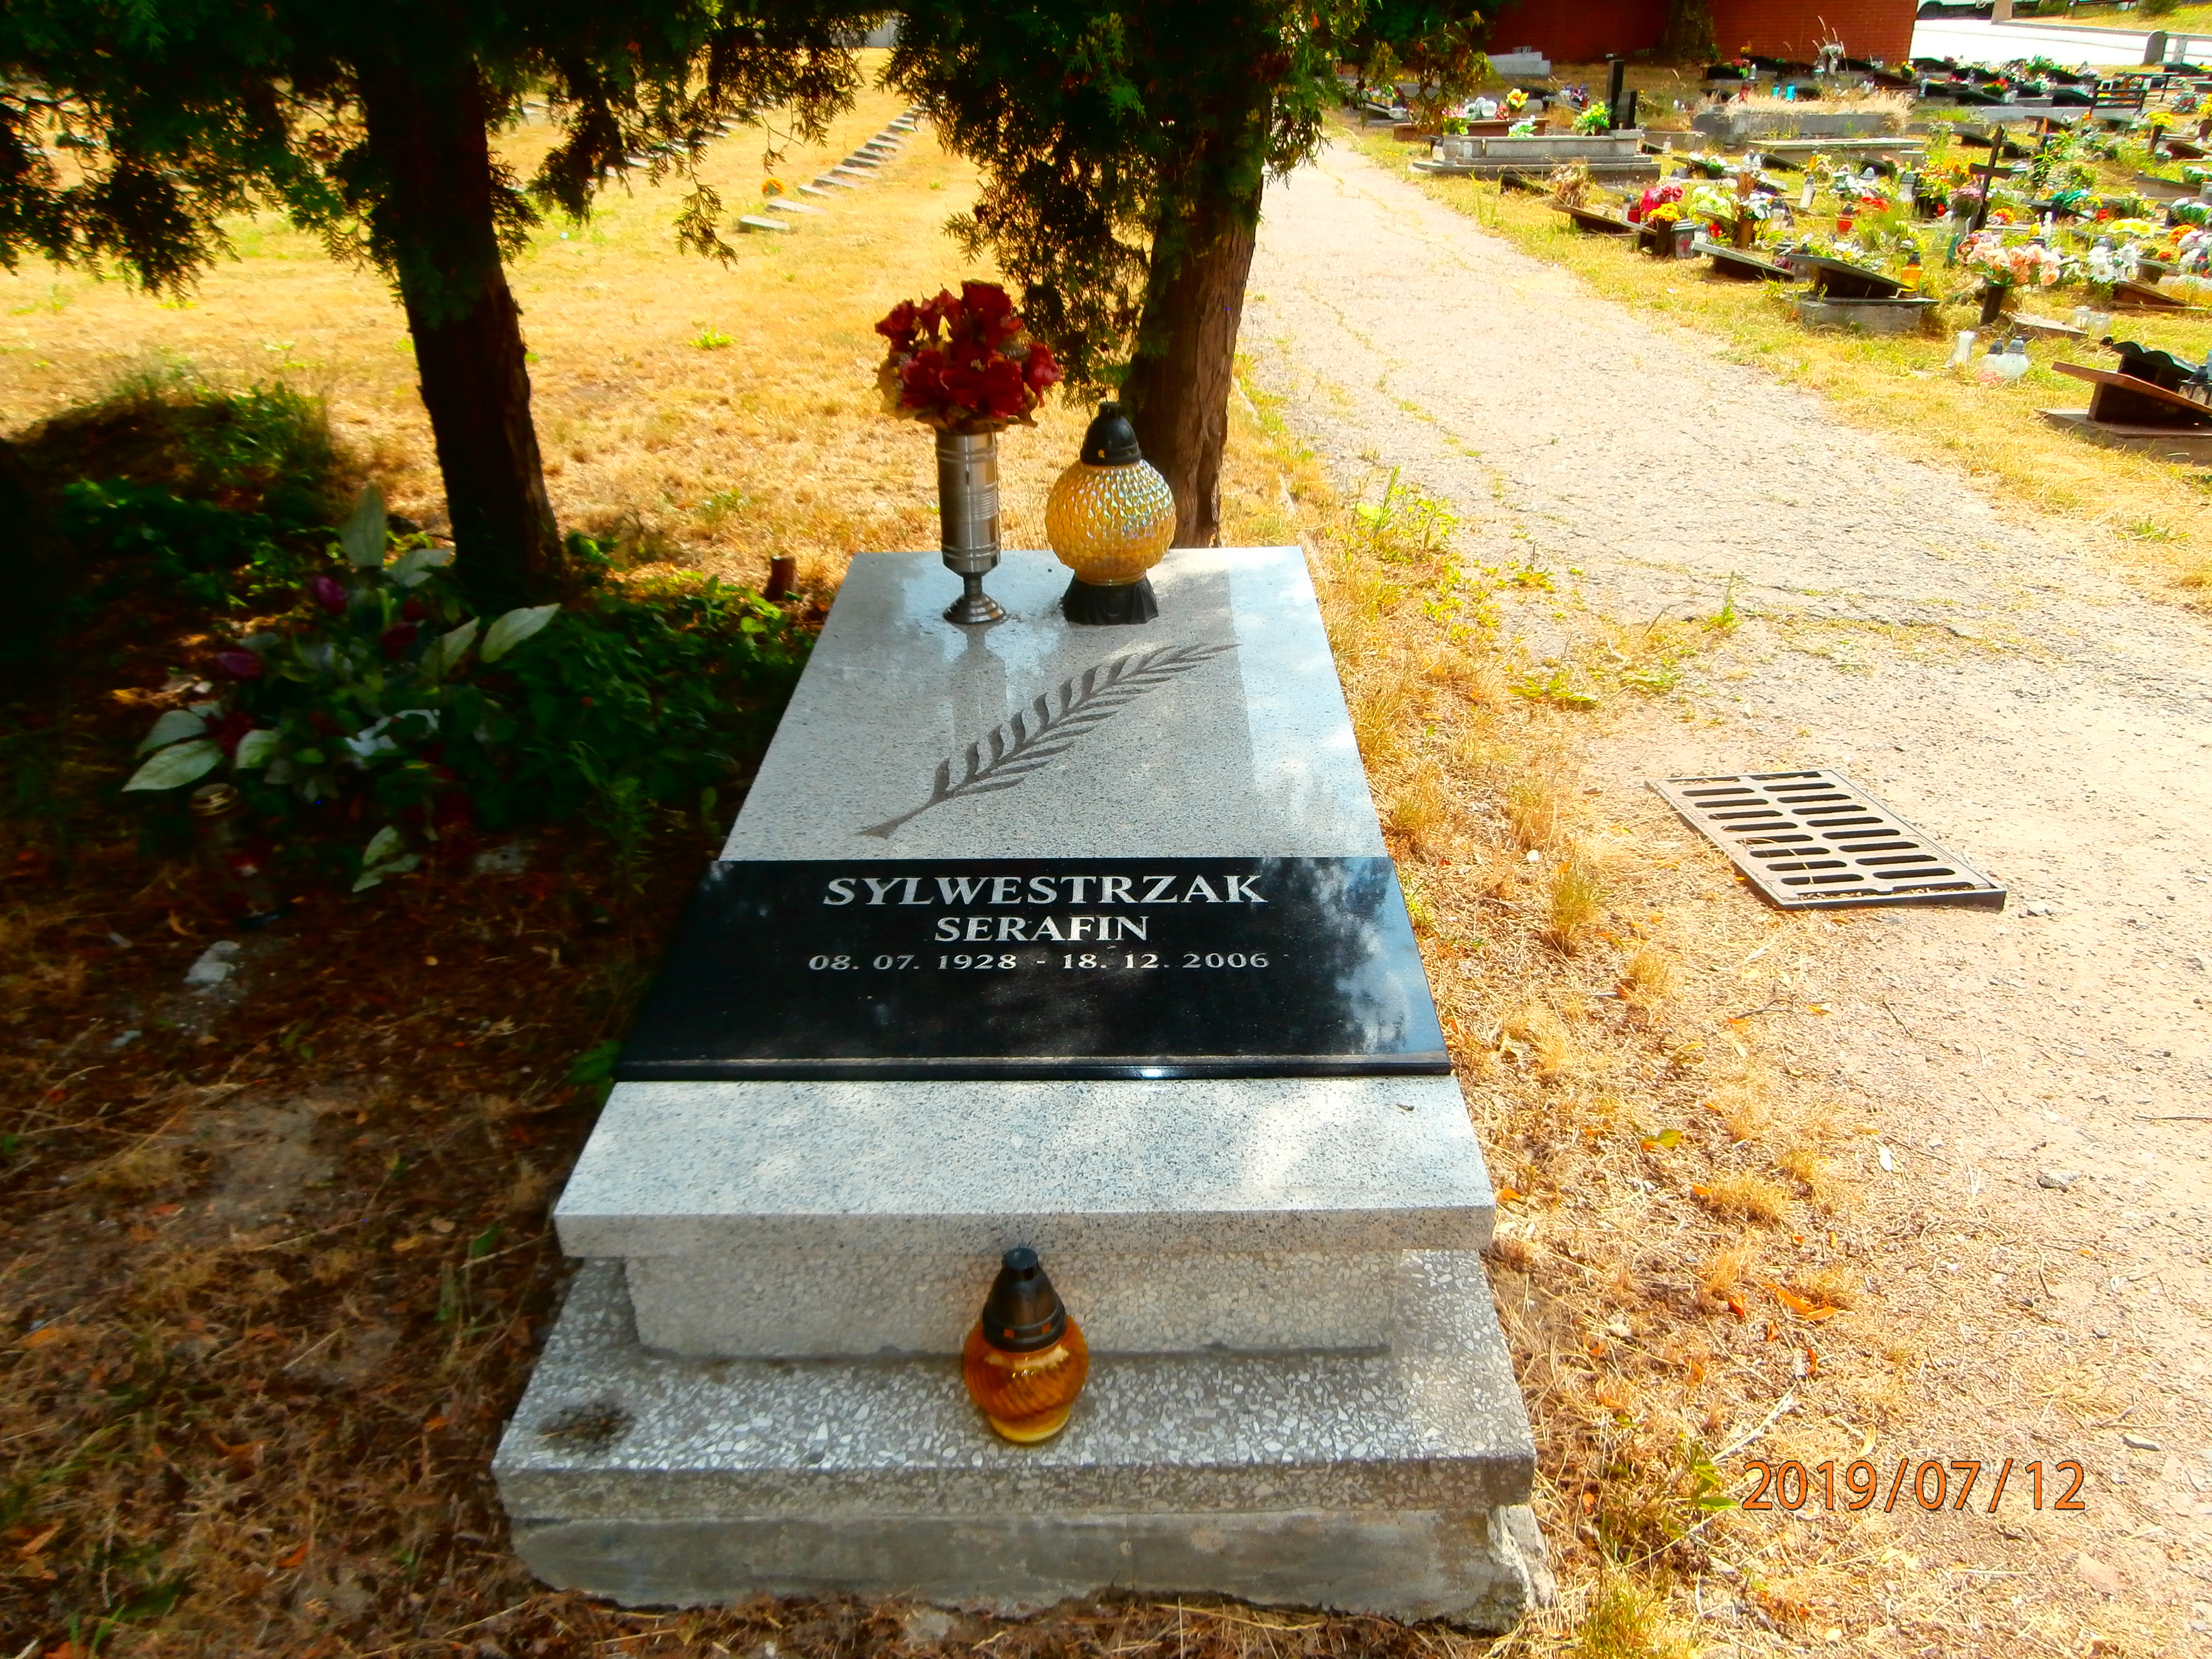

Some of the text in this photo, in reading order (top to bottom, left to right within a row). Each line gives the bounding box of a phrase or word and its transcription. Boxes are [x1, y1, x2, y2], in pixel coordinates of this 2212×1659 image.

[823, 875, 1269, 905] SYLWESTRZAK
[935, 915, 1150, 942] SERAFIN
[808, 955, 859, 970] 08.
[873, 954, 920, 970] 07.
[938, 954, 1017, 970] 1928
[1062, 953, 1107, 969] 18.
[1124, 953, 1170, 969] 12.
[1182, 952, 1269, 969] 2006
